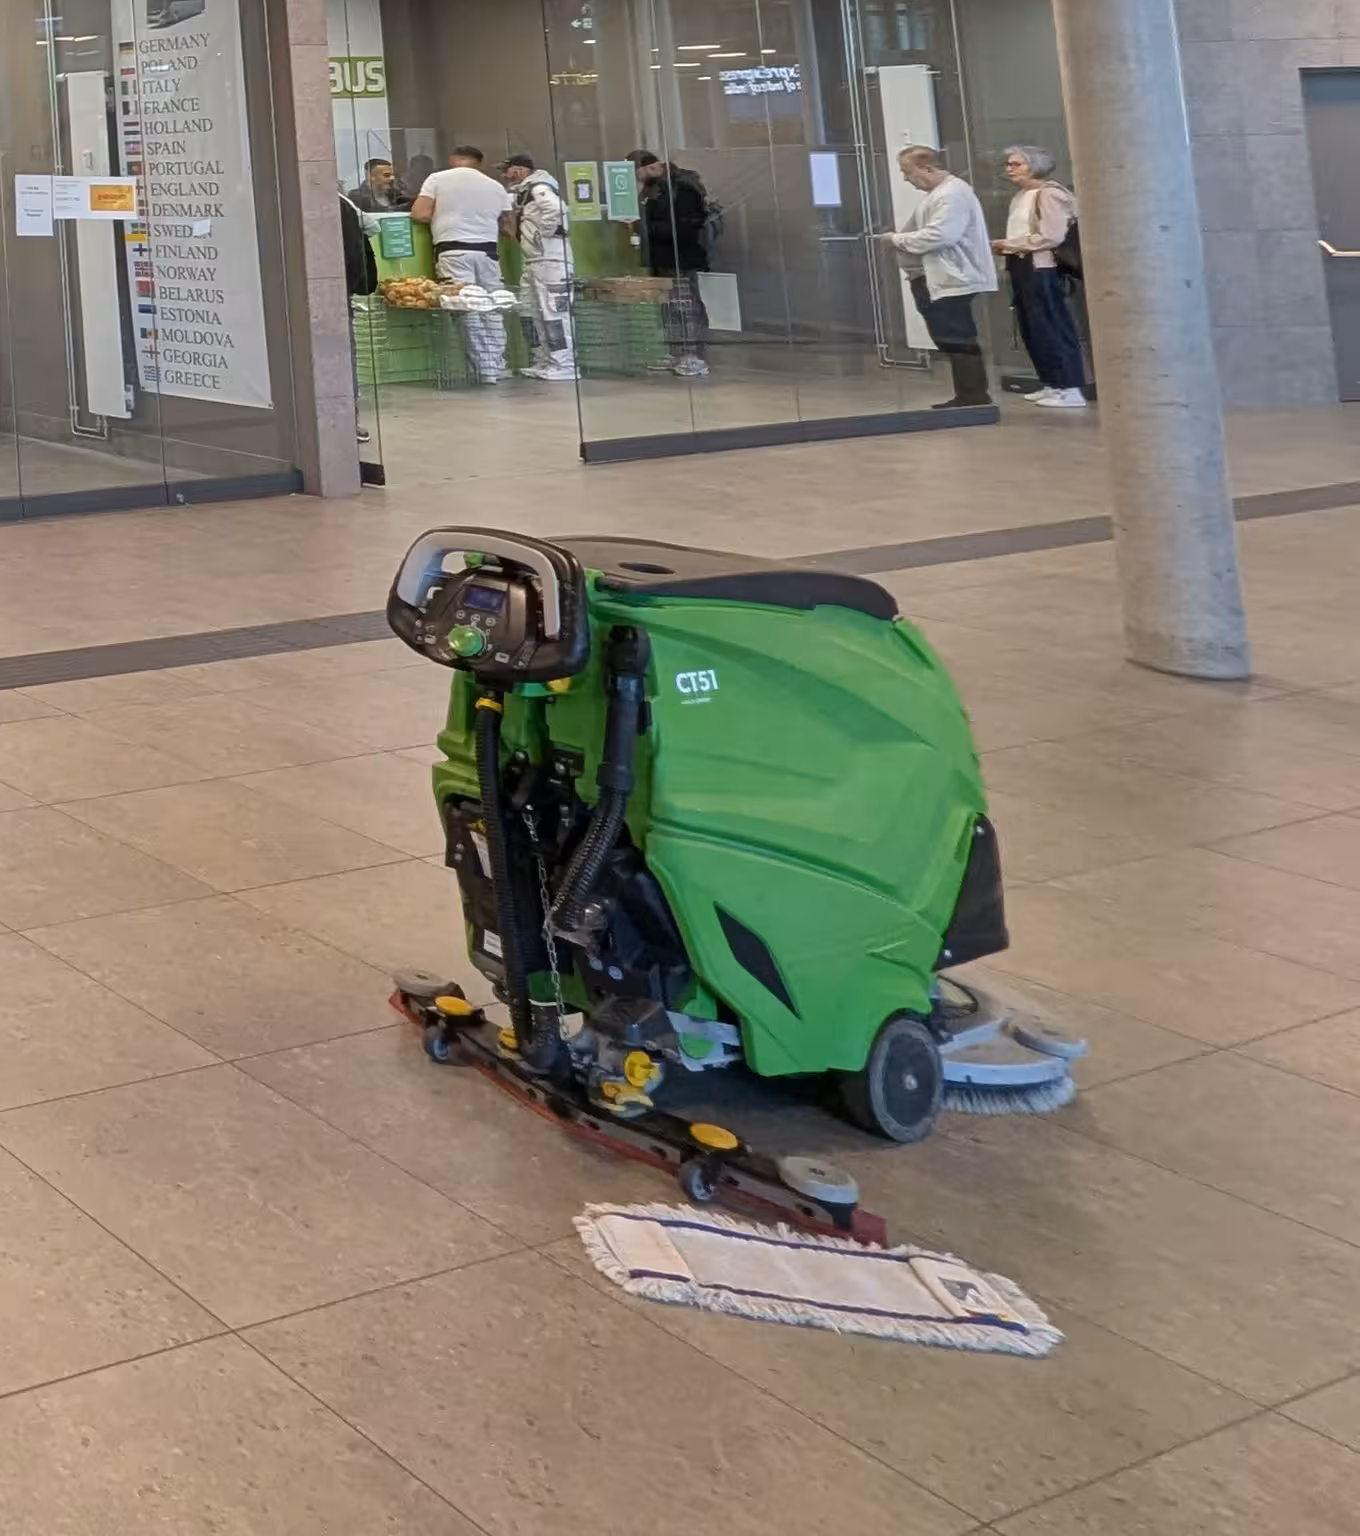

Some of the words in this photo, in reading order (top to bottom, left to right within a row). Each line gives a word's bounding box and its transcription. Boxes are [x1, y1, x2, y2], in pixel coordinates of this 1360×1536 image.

[139, 33, 210, 54] GERMANY
[141, 56, 198, 74] POLAND
[142, 78, 181, 95] ITALY
[144, 97, 200, 115] FRANCE
[144, 118, 213, 135] HOLLAND
[146, 140, 186, 156] SPAIN
[149, 160, 225, 176] PORTUGAL
[151, 182, 220, 197] ENGLAND
[152, 203, 224, 218] DENMARK
[153, 223, 212, 239] SWED
[155, 244, 218, 261] FINLAND
[156, 264, 216, 282] NORWAY
[159, 286, 224, 304] BELARUS
[160, 306, 222, 325] ESTONIA
[161, 327, 235, 348] MOLDOVA
[162, 348, 228, 369] GEORGIA
[164, 369, 221, 389] GREECE
[675, 669, 719, 693] CT51
